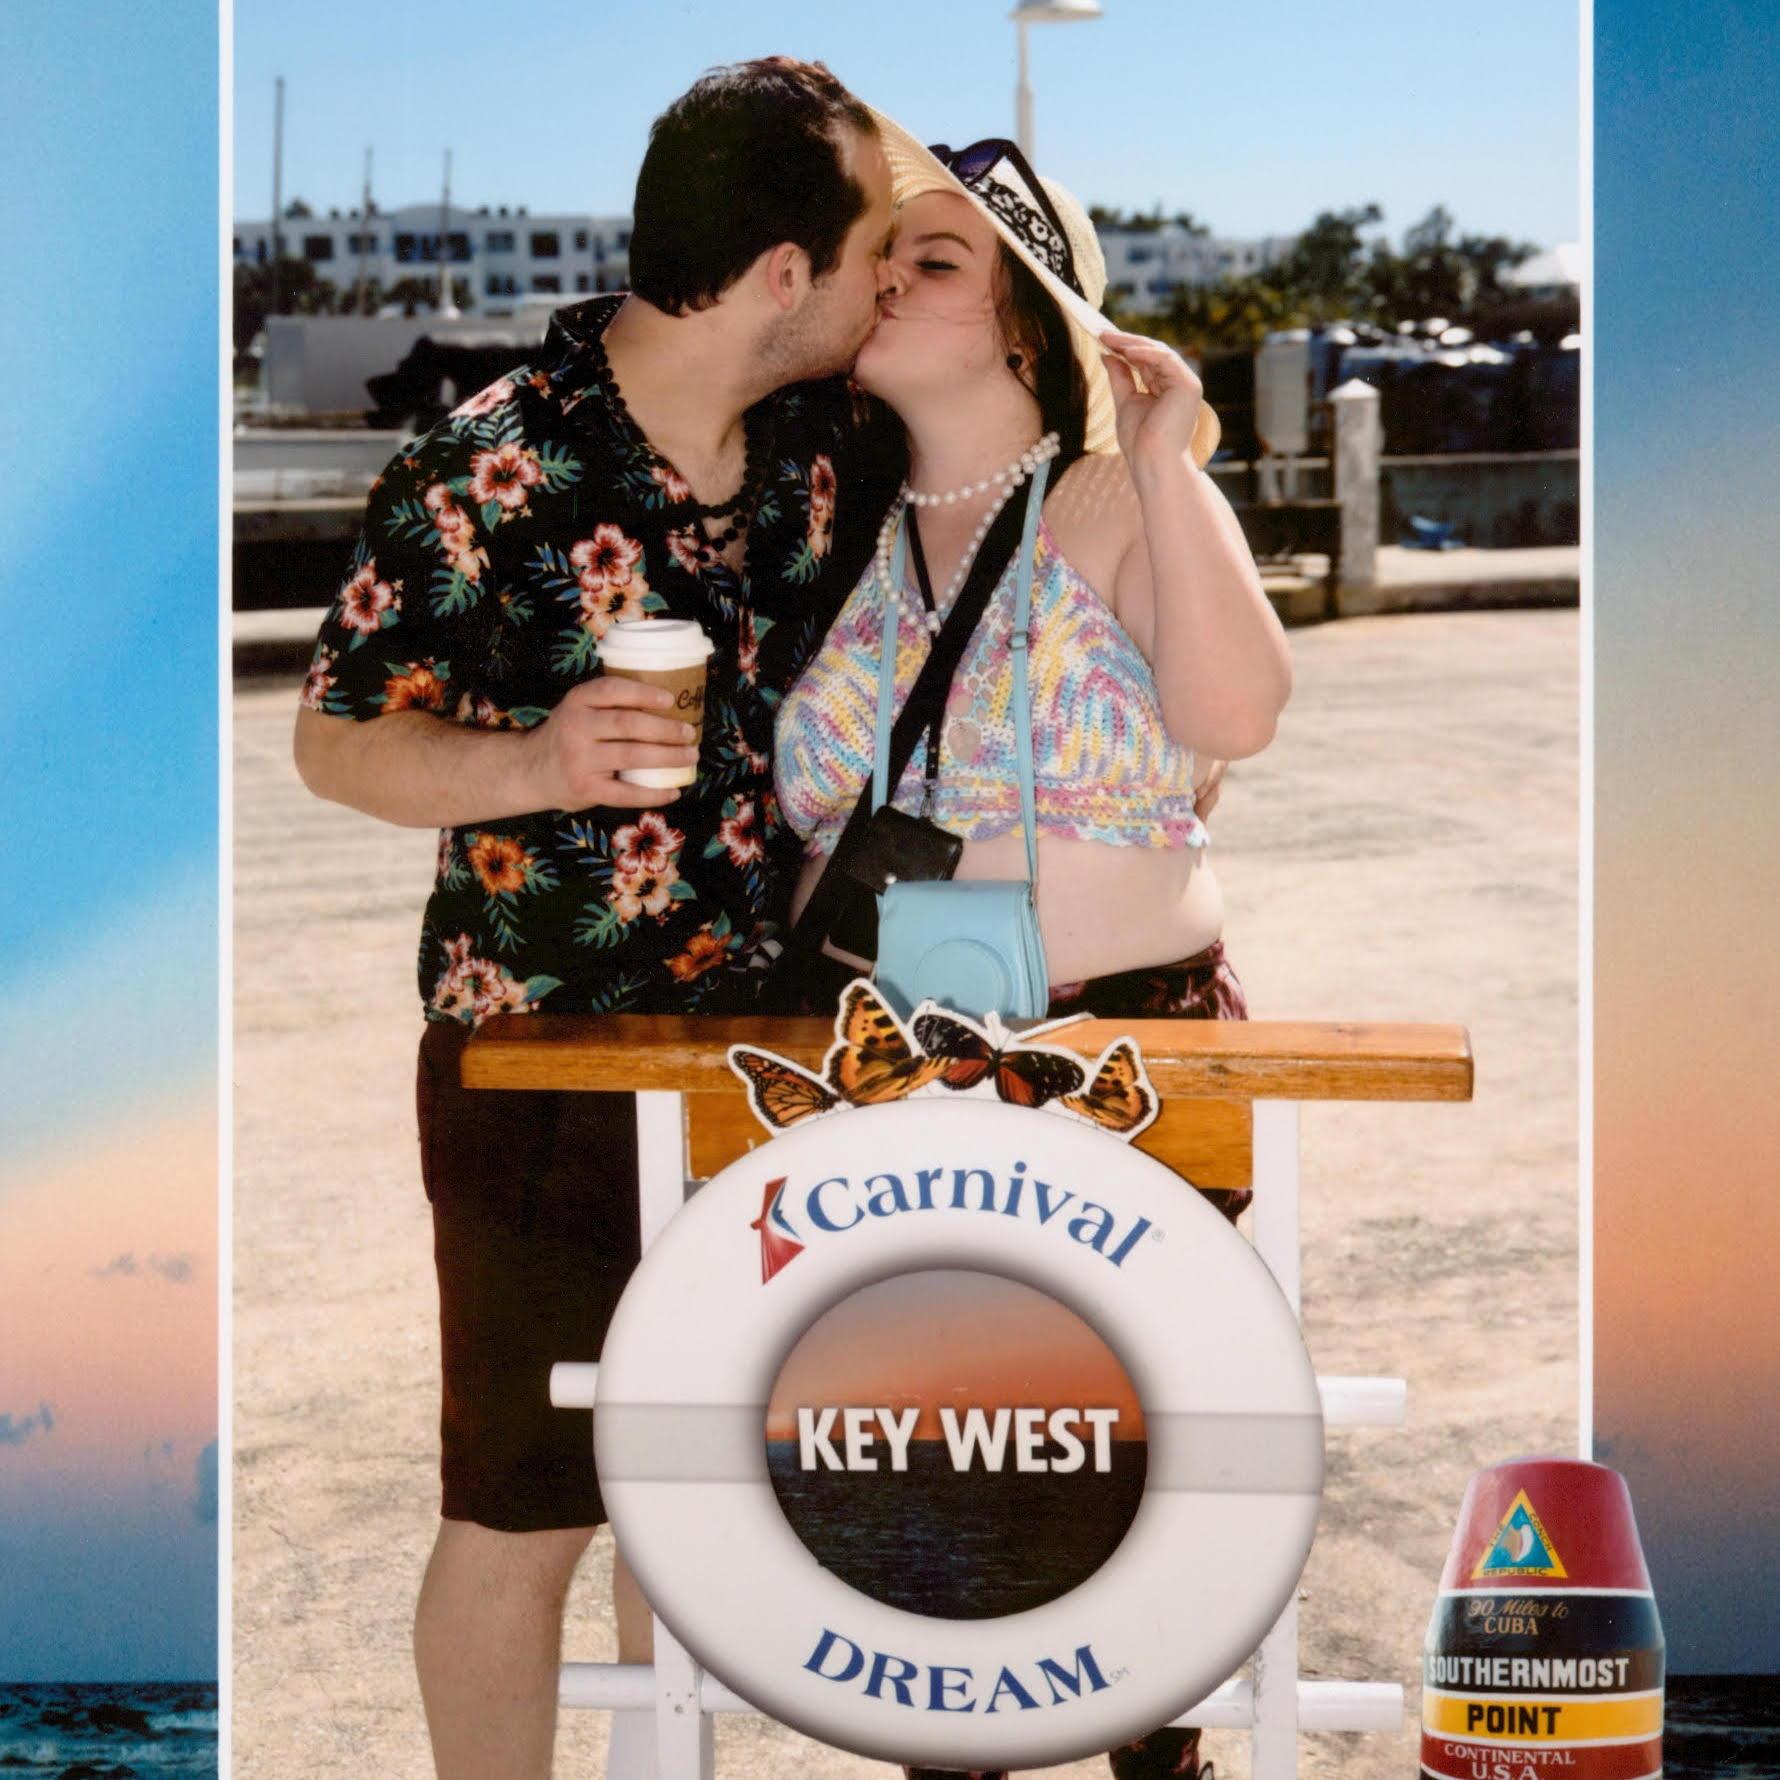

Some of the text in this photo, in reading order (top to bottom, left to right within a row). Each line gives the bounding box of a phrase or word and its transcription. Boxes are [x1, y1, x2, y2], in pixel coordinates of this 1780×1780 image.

[805, 1161, 1154, 1267] Carnival
[798, 1408, 1120, 1473] KEY WEST
[1467, 1599, 1569, 1620] 90 Miles to
[1484, 1616, 1539, 1636] CUBA
[802, 1627, 1111, 1714] DREAM
[1429, 1655, 1631, 1689] SOUTHERNMOST
[1467, 1704, 1563, 1736] POINT
[1444, 1743, 1577, 1766] CONTINENTAL
